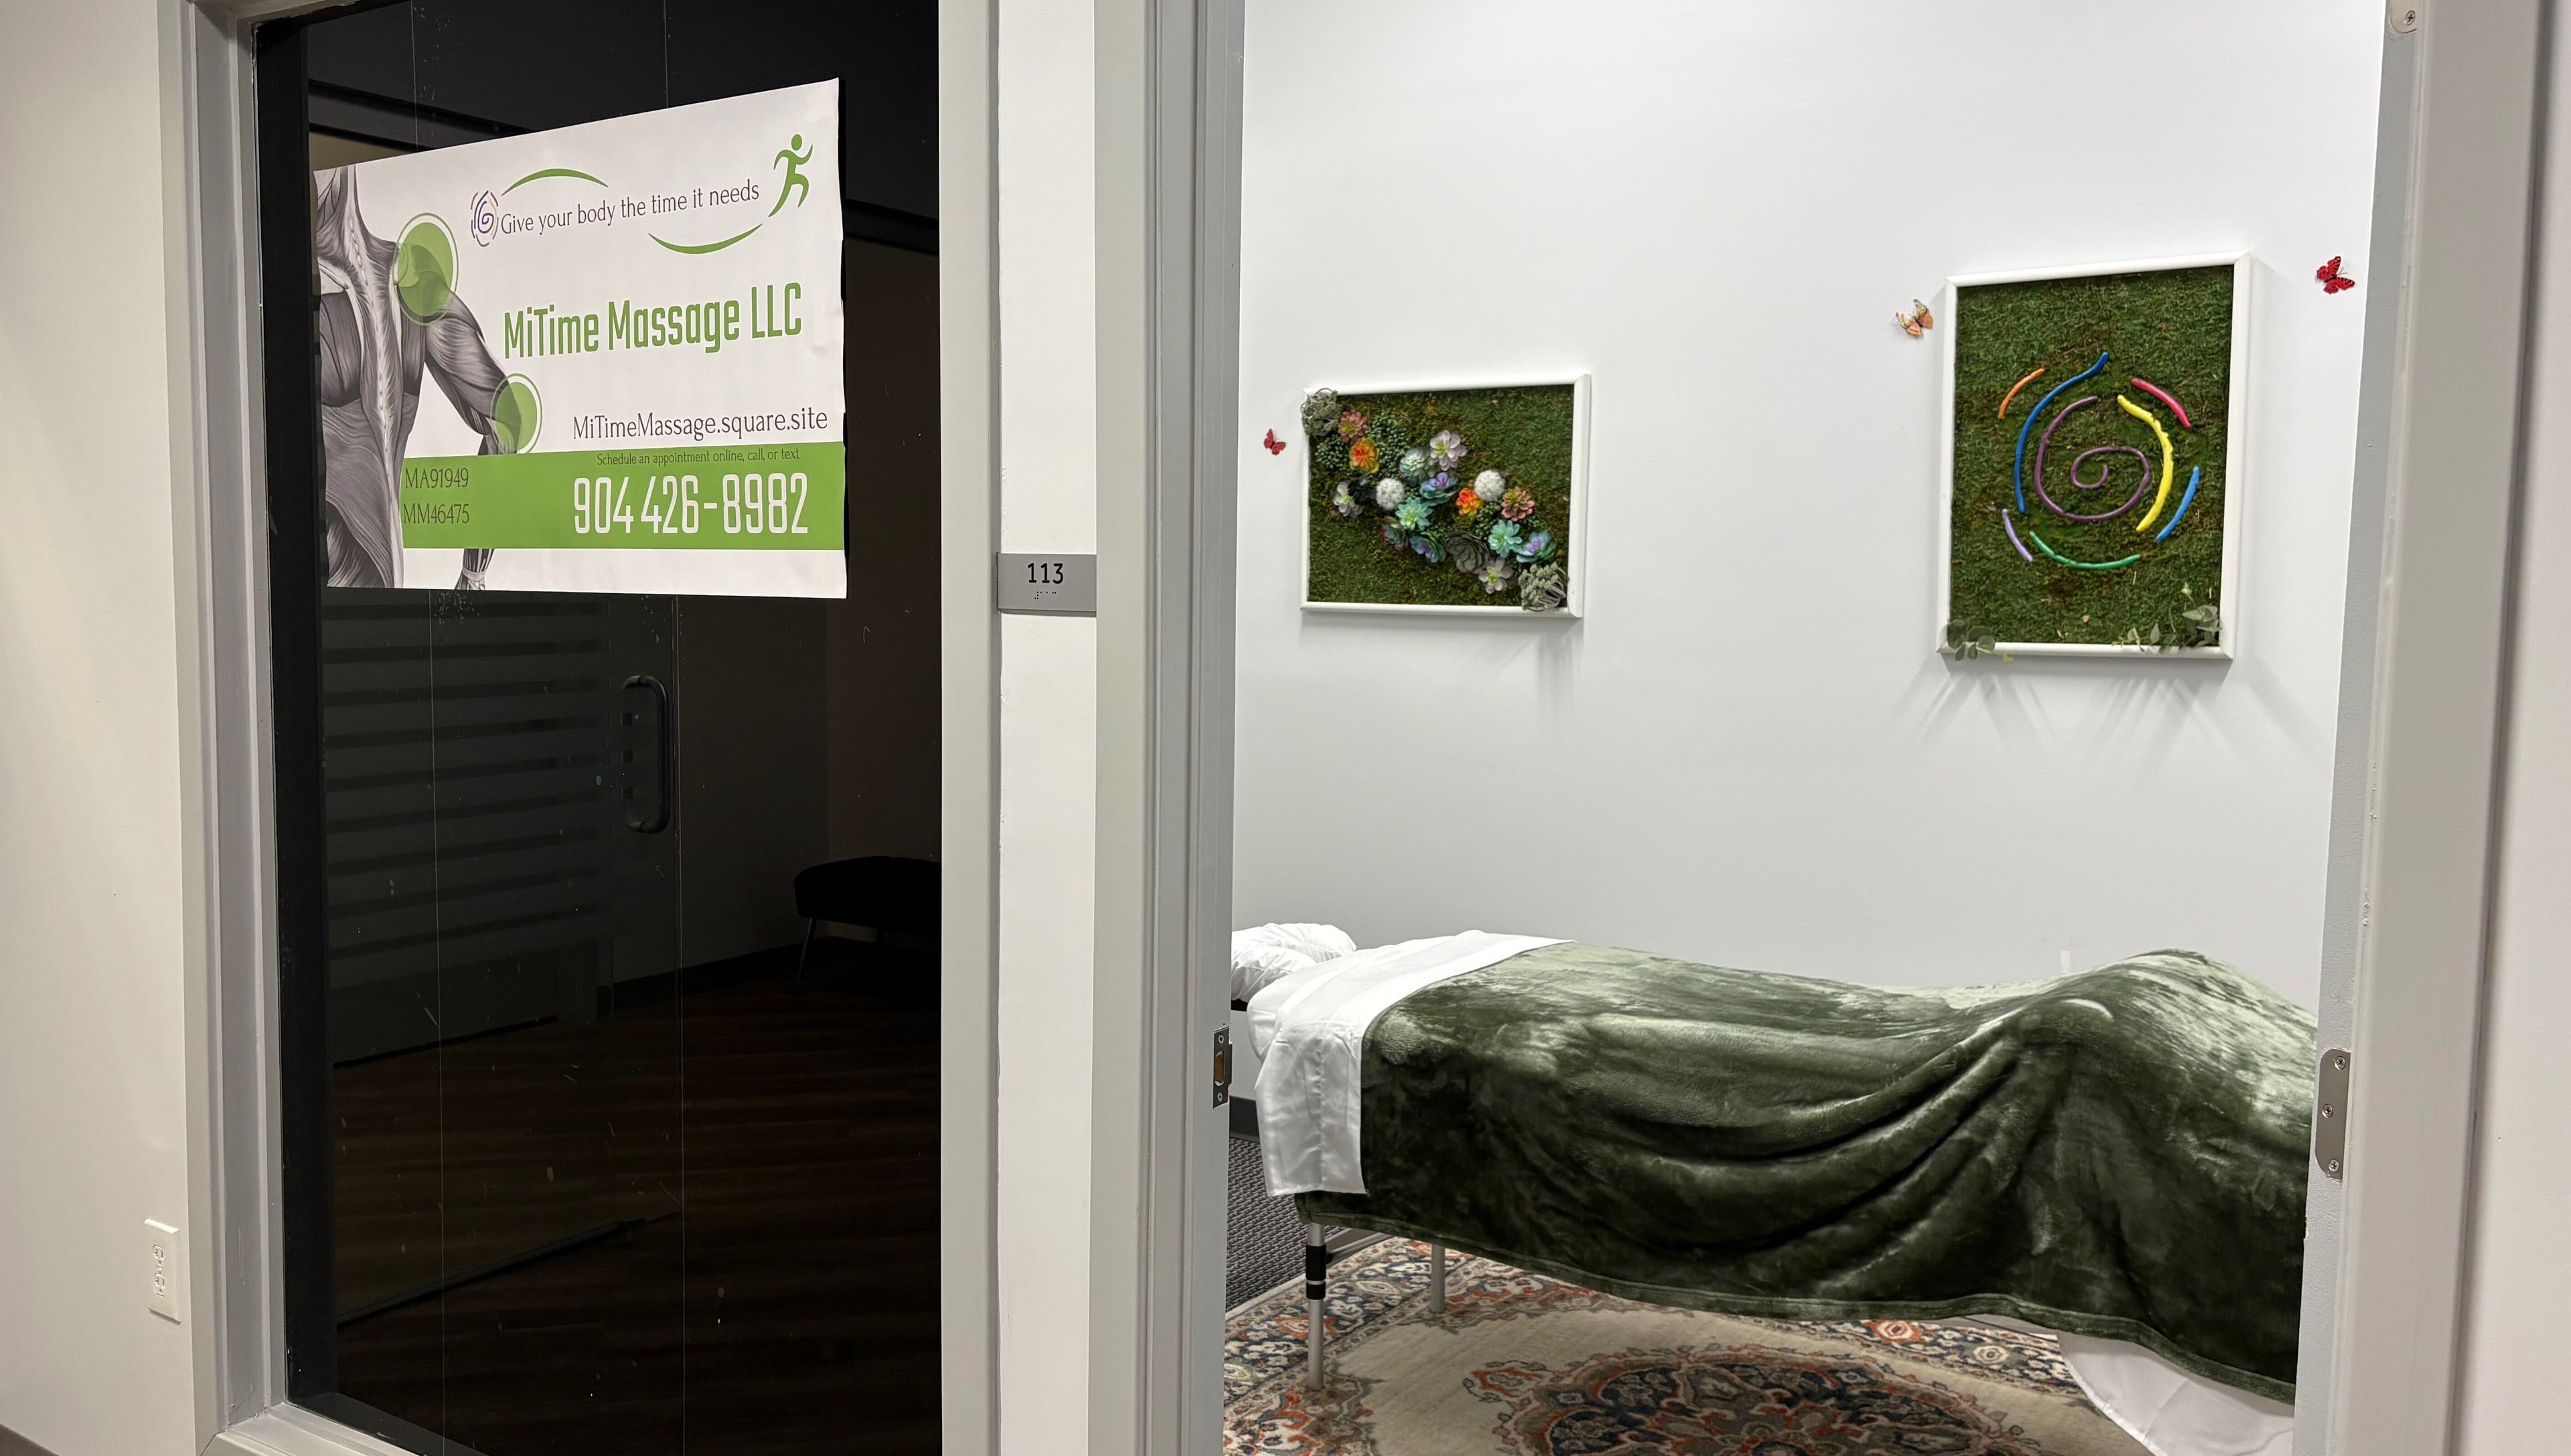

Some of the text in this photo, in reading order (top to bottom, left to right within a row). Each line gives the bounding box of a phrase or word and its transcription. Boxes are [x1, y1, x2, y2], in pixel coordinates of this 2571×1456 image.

[501, 179, 760, 236] Give your body the time it needs
[504, 282, 802, 359] MiTime Massage LLC
[573, 407, 828, 441] MiTimeMassage.square.site
[597, 447, 800, 467] Schedule an appointment online, call, or text
[405, 467, 469, 489] MA91949
[403, 503, 470, 524] MM46475
[574, 472, 808, 534] 904 426-8982
[1027, 562, 1064, 584] 113
